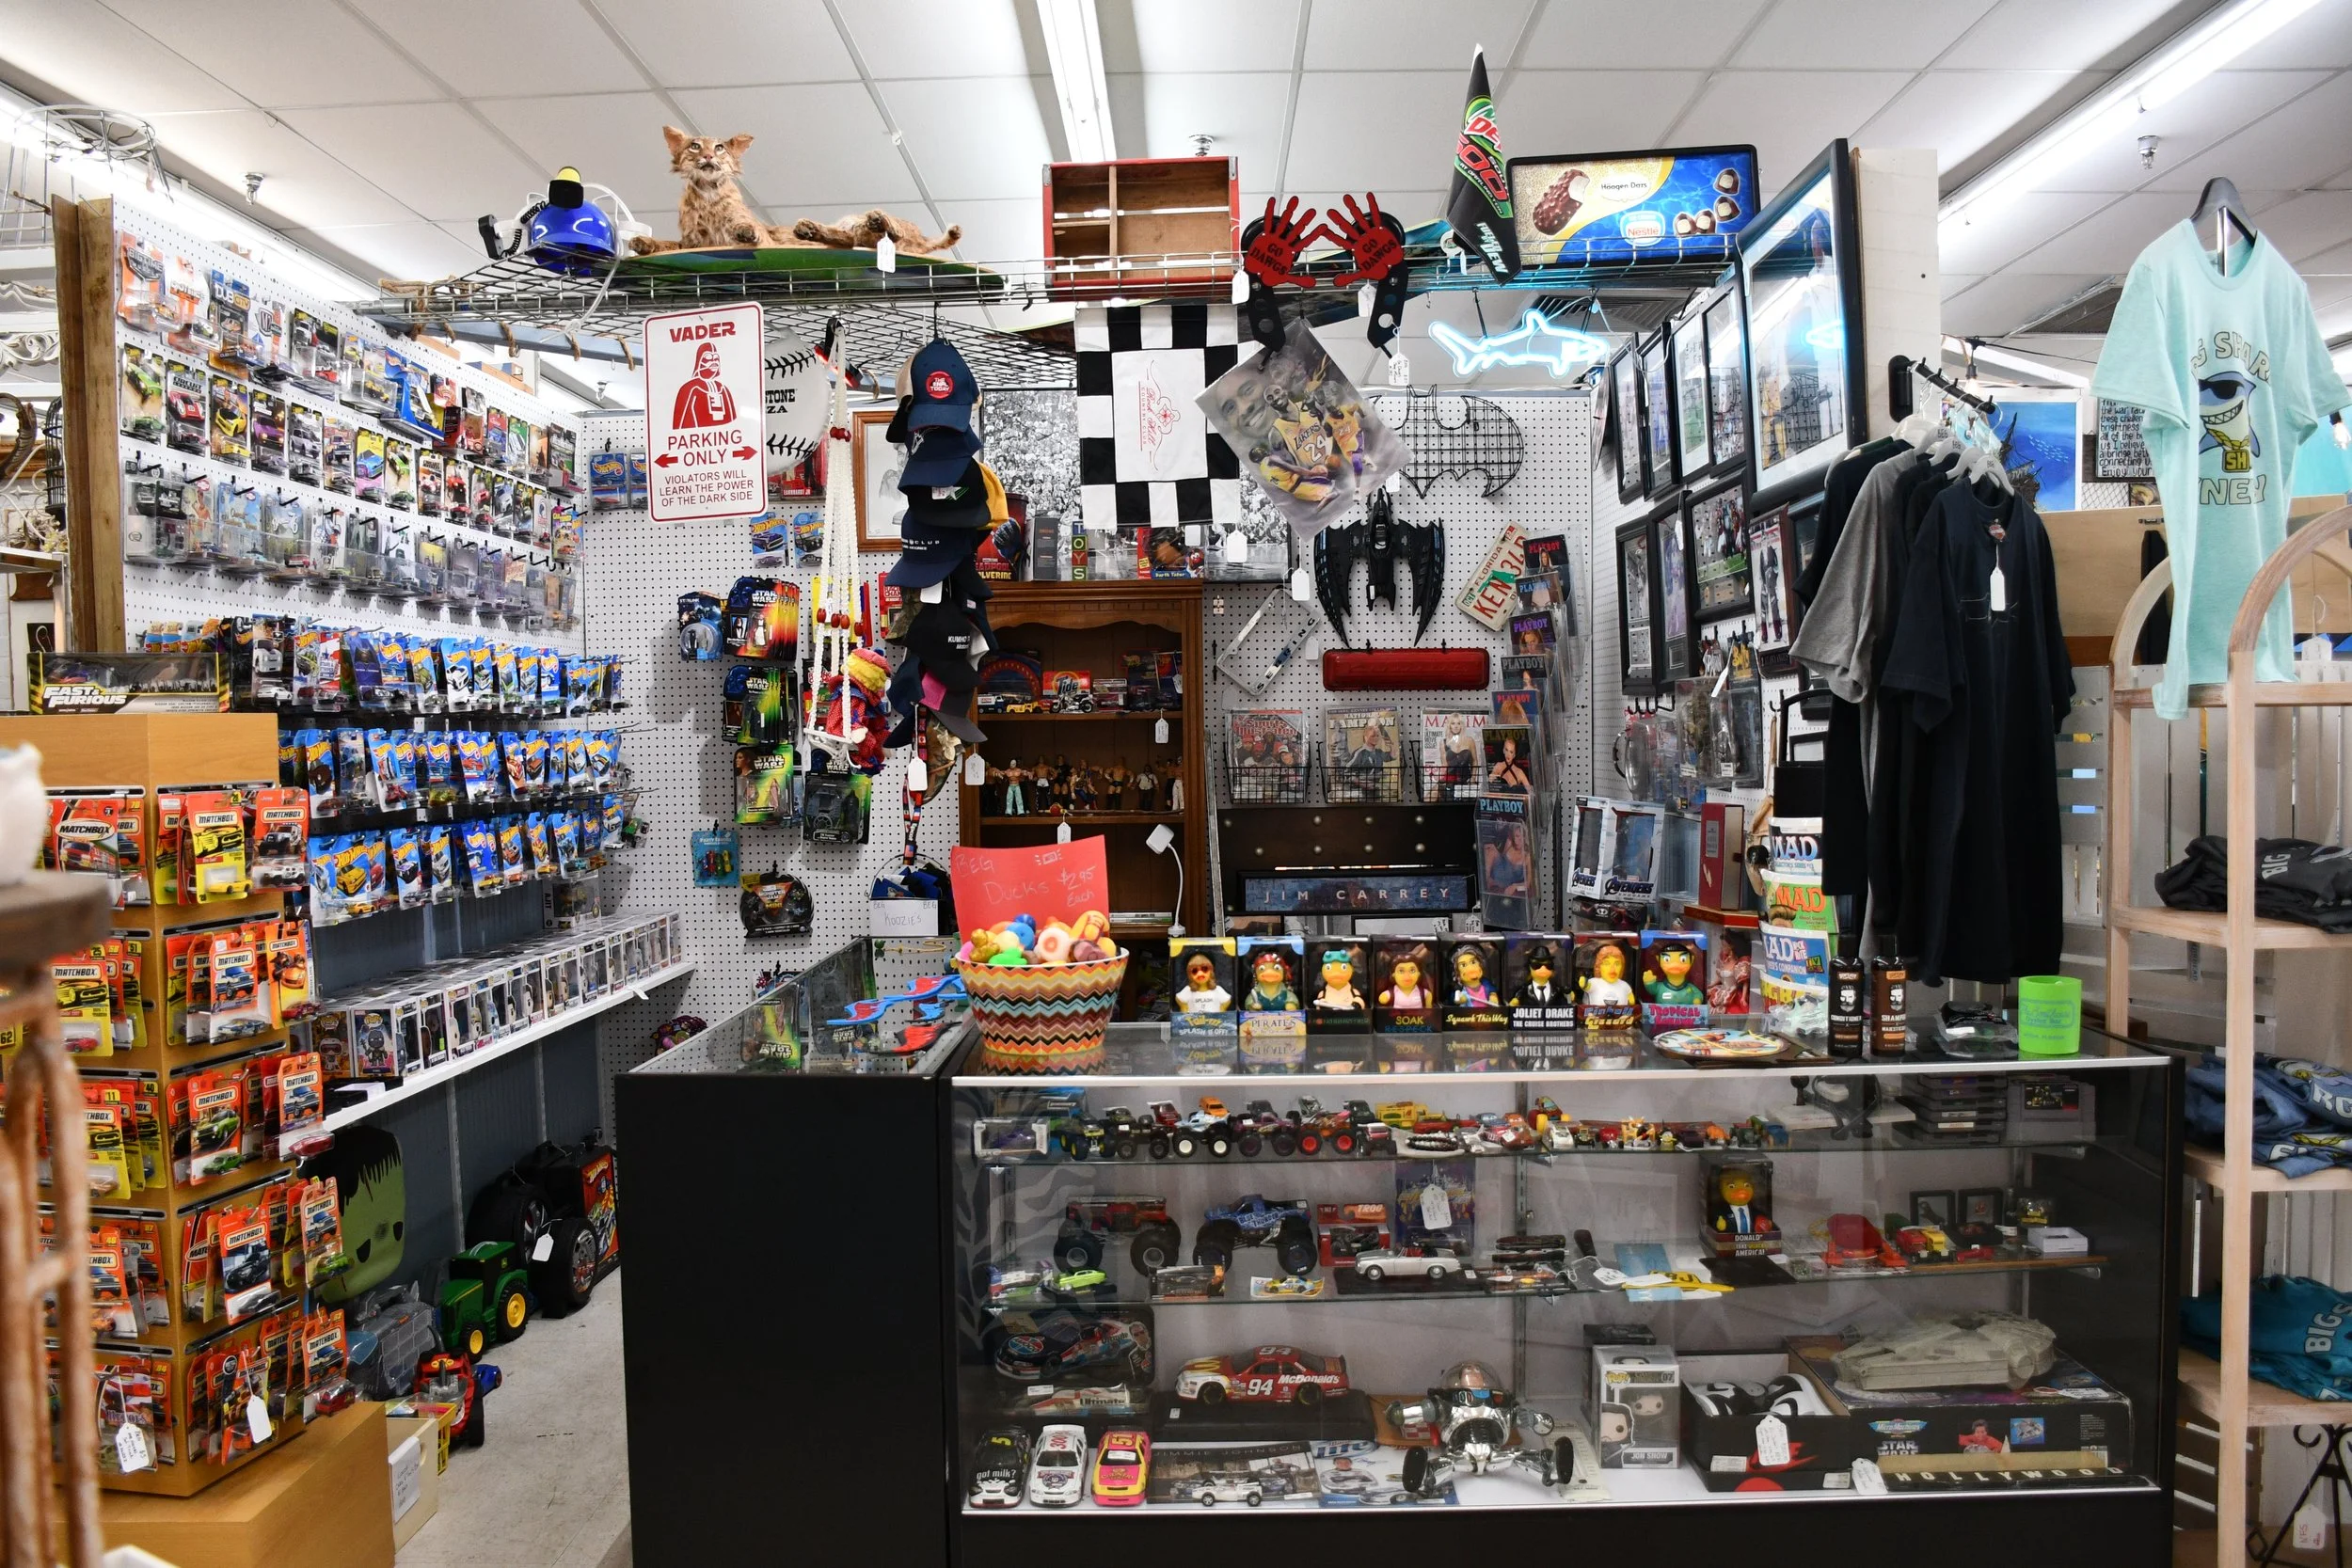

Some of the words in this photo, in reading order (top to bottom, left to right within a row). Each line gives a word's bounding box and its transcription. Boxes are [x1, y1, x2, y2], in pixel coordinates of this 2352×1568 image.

[1267, 243, 1283, 258] GO
[1362, 238, 1378, 254] GO
[1249, 247, 1288, 276] DAWGS
[1361, 239, 1397, 271] DAWGS
[215, 285, 233, 304] DUB
[670, 322, 736, 342] VADER
[2101, 422, 2139, 432] brightness
[668, 429, 742, 451] PARKING
[1294, 421, 1321, 451] LAKERS
[1303, 434, 1327, 463] 24
[684, 449, 727, 467] ONLY
[2099, 457, 2142, 467] connecting
[2225, 451, 2248, 470] SH
[665, 471, 720, 484] VIOLATORS
[723, 469, 747, 480] WILL
[2101, 467, 2128, 478] Enjoy
[2133, 467, 2152, 477] your
[660, 483, 692, 497] LEARN
[694, 482, 714, 494] THE
[717, 479, 754, 492] POWER
[661, 497, 675, 507] OF
[677, 495, 696, 505] THE
[699, 493, 727, 504] DARK
[730, 490, 753, 501] SIDE
[752, 523, 767, 533] HOT
[766, 519, 787, 530] WHEELS
[801, 524, 812, 533] HOT
[1473, 546, 1502, 586] FLORIDA
[1473, 576, 1513, 620] KEN
[1514, 618, 1548, 633] PLAYBOY
[1502, 657, 1544, 670] PLAYBOY
[1057, 675, 1078, 695] Tide
[43, 686, 93, 699] FAST
[48, 694, 127, 708] FURIOUS
[1238, 726, 1297, 736] Illustrated
[1245, 720, 1287, 728] Sports
[755, 754, 785, 764] STAR
[755, 761, 785, 769] WARS
[1480, 798, 1524, 815] PLAYBOY
[199, 815, 235, 825] MATCHBOX
[266, 810, 302, 819] MATCHBOX
[59, 823, 112, 836] MATCHBOX
[1772, 835, 1819, 862] MAD
[338, 853, 350, 866] HOT
[2261, 852, 2292, 880] BIG
[1572, 873, 1597, 888] AVENGERS
[1605, 878, 1654, 895] AVENGERS
[1067, 890, 1094, 908] Each
[1264, 891, 1309, 903] JIM
[1336, 888, 1449, 900] CARREY
[1774, 885, 1826, 913] MAD
[272, 941, 297, 949] MATCHBOX
[218, 955, 250, 966] MATCHBOX
[55, 966, 98, 977] MATCHBOX
[1513, 1007, 1542, 1019] JOLIET
[1545, 1007, 1574, 1019] DRAKE
[1583, 1006, 1634, 1017] Pinball
[1648, 1004, 1701, 1017] TROPICAL
[1251, 1019, 1296, 1028] PIRATES
[1395, 1015, 1424, 1025] SOAK
[1446, 1014, 1475, 1023] Squawk
[1475, 1014, 1491, 1023] This
[1491, 1014, 1508, 1024] Way
[1513, 1020, 1523, 1028] THE
[1524, 1020, 1545, 1028] CRUISE
[1546, 1020, 1574, 1028] BROTHERS
[286, 1075, 315, 1086] MATCHBOX
[198, 1091, 234, 1105] MATCHBOX
[307, 1199, 332, 1213] MATCHBOX
[1237, 1213, 1254, 1225] BLUE
[1253, 1213, 1279, 1227] THUNDER
[229, 1227, 264, 1244] MATCHBOX
[2305, 1311, 2342, 1354] BIG
[310, 1331, 339, 1353] MATCHBOX
[1259, 1345, 1293, 1356] 94
[1278, 1374, 1340, 1385] McDonald's
[1606, 1372, 1630, 1386] POP!
[1661, 1373, 1674, 1382] 07
[1247, 1378, 1274, 1396] 94
[1080, 1398, 1125, 1406] Ultimate
[991, 1436, 1012, 1446] 5
[1111, 1433, 1134, 1446] 51
[1877, 1440, 1919, 1450] STAR
[1221, 1444, 1302, 1456] JOHNSON
[977, 1469, 991, 1481] got
[992, 1468, 1017, 1479] milk?
[1895, 1466, 2123, 1482] HOLLYWOOD
